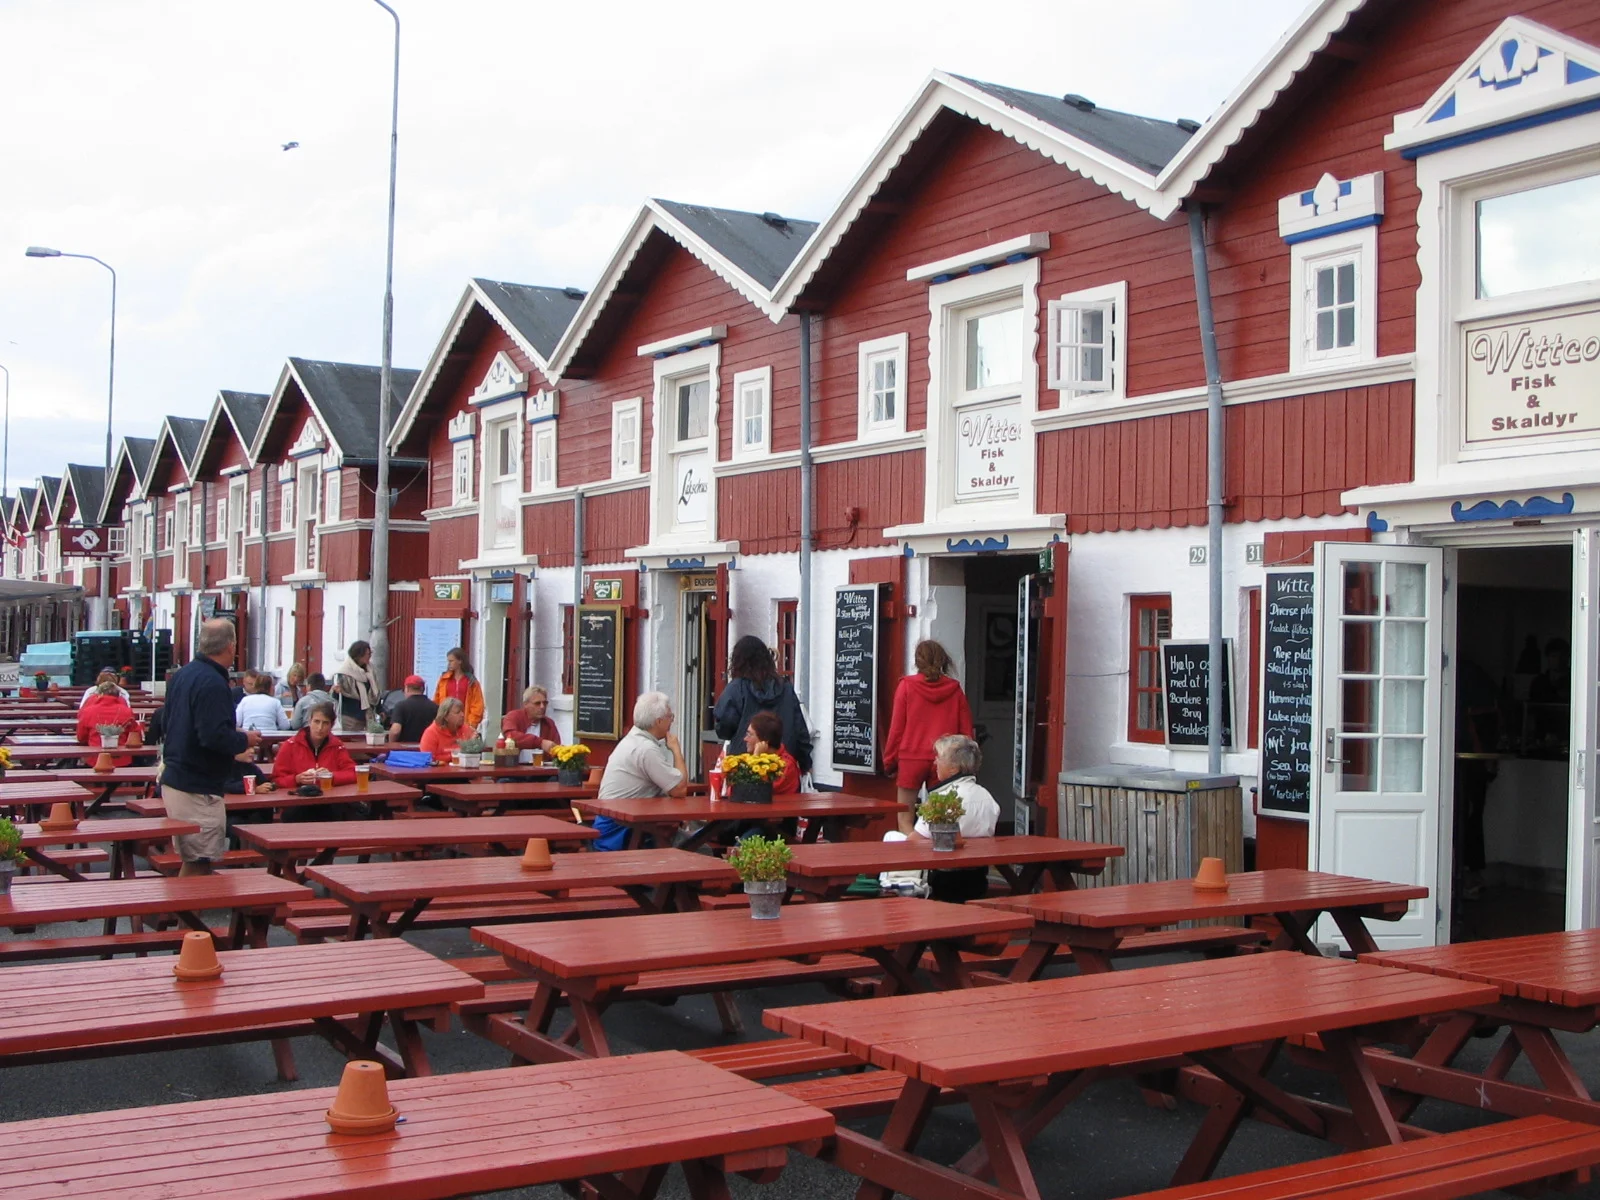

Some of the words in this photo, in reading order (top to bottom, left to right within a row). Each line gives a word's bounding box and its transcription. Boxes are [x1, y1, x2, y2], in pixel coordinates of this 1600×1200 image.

[1471, 327, 1600, 375] Wittco
[1511, 374, 1556, 391] Fisk
[1526, 394, 1540, 408] &
[1492, 412, 1578, 431] Skaldyr
[961, 414, 1021, 447] Wittc
[981, 448, 1004, 459] Fisk
[989, 462, 996, 472] &
[971, 475, 1015, 488] Skaldyr
[84, 536, 94, 544] N
[1191, 548, 1205, 563] 29
[1248, 545, 1260, 561] 31
[1170, 654, 1194, 676] Hjælp
[1170, 674, 1188, 688] med
[1189, 675, 1200, 688] at
[1270, 760, 1292, 771] Sea
